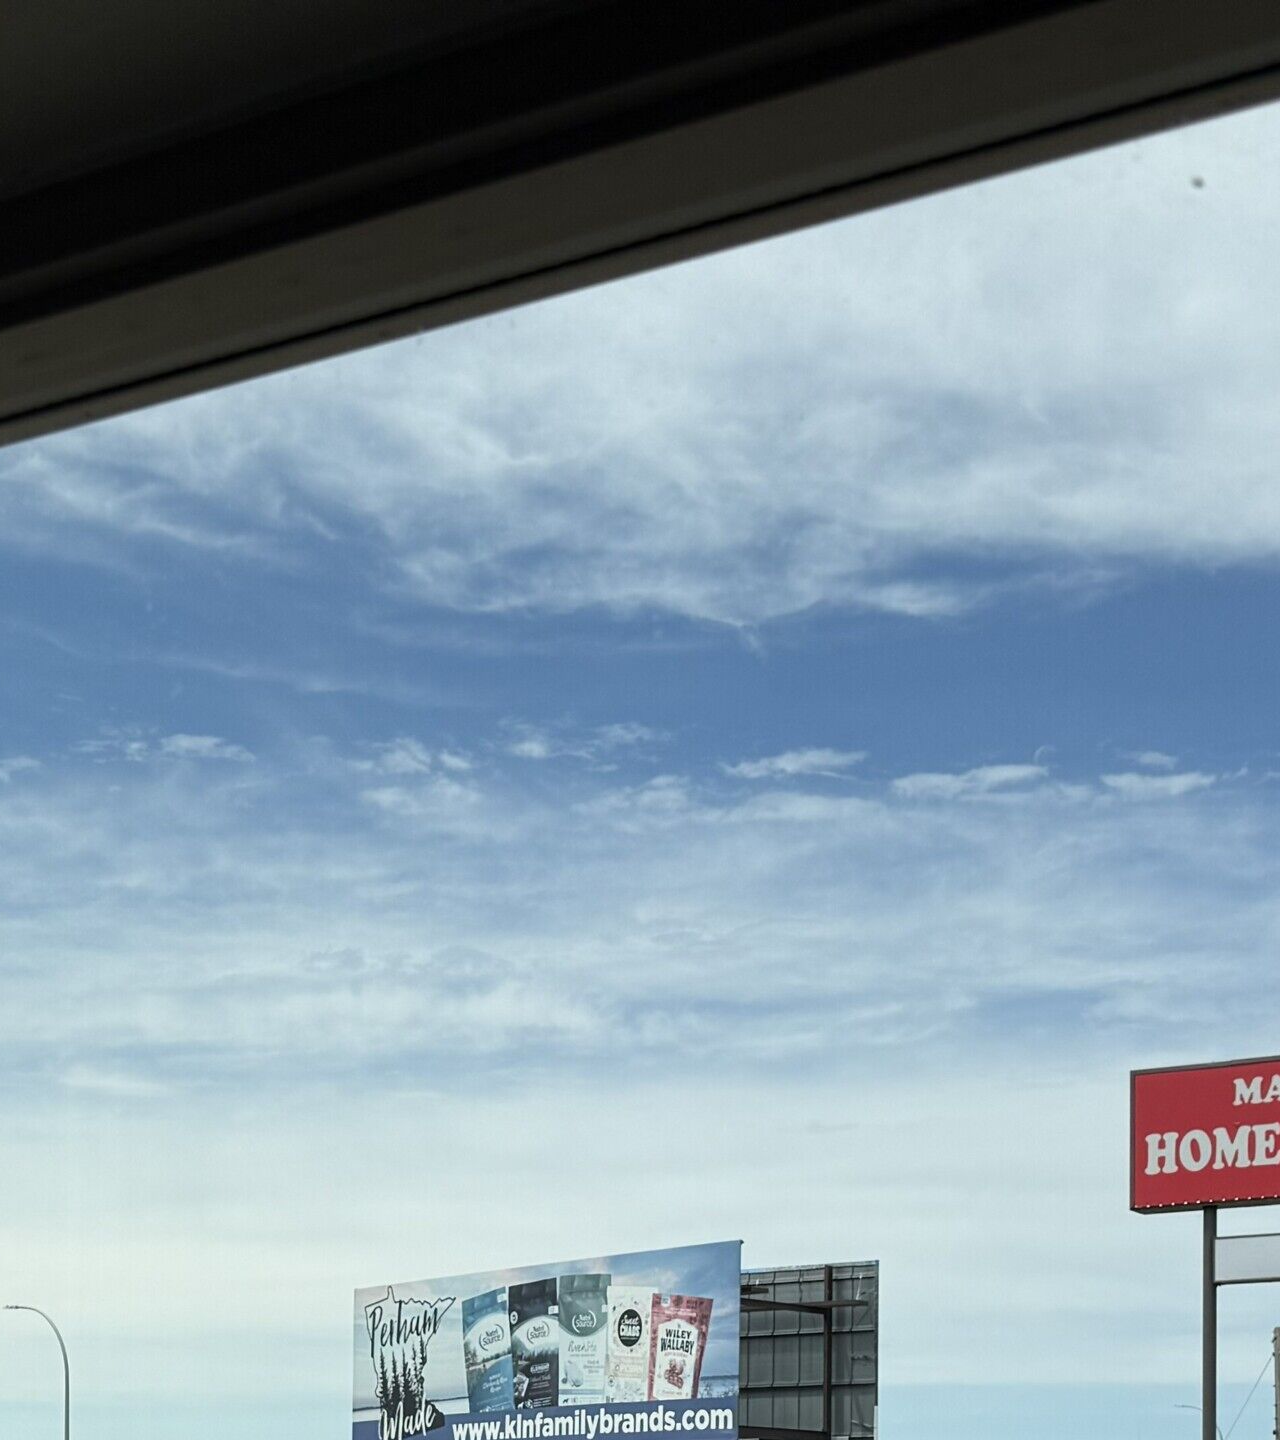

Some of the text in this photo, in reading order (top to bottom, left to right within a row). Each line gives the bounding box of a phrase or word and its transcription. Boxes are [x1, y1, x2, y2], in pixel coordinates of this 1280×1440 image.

[369, 1300, 438, 1358] Perham
[665, 1328, 692, 1340] WILEY
[661, 1337, 695, 1356] WALLABY
